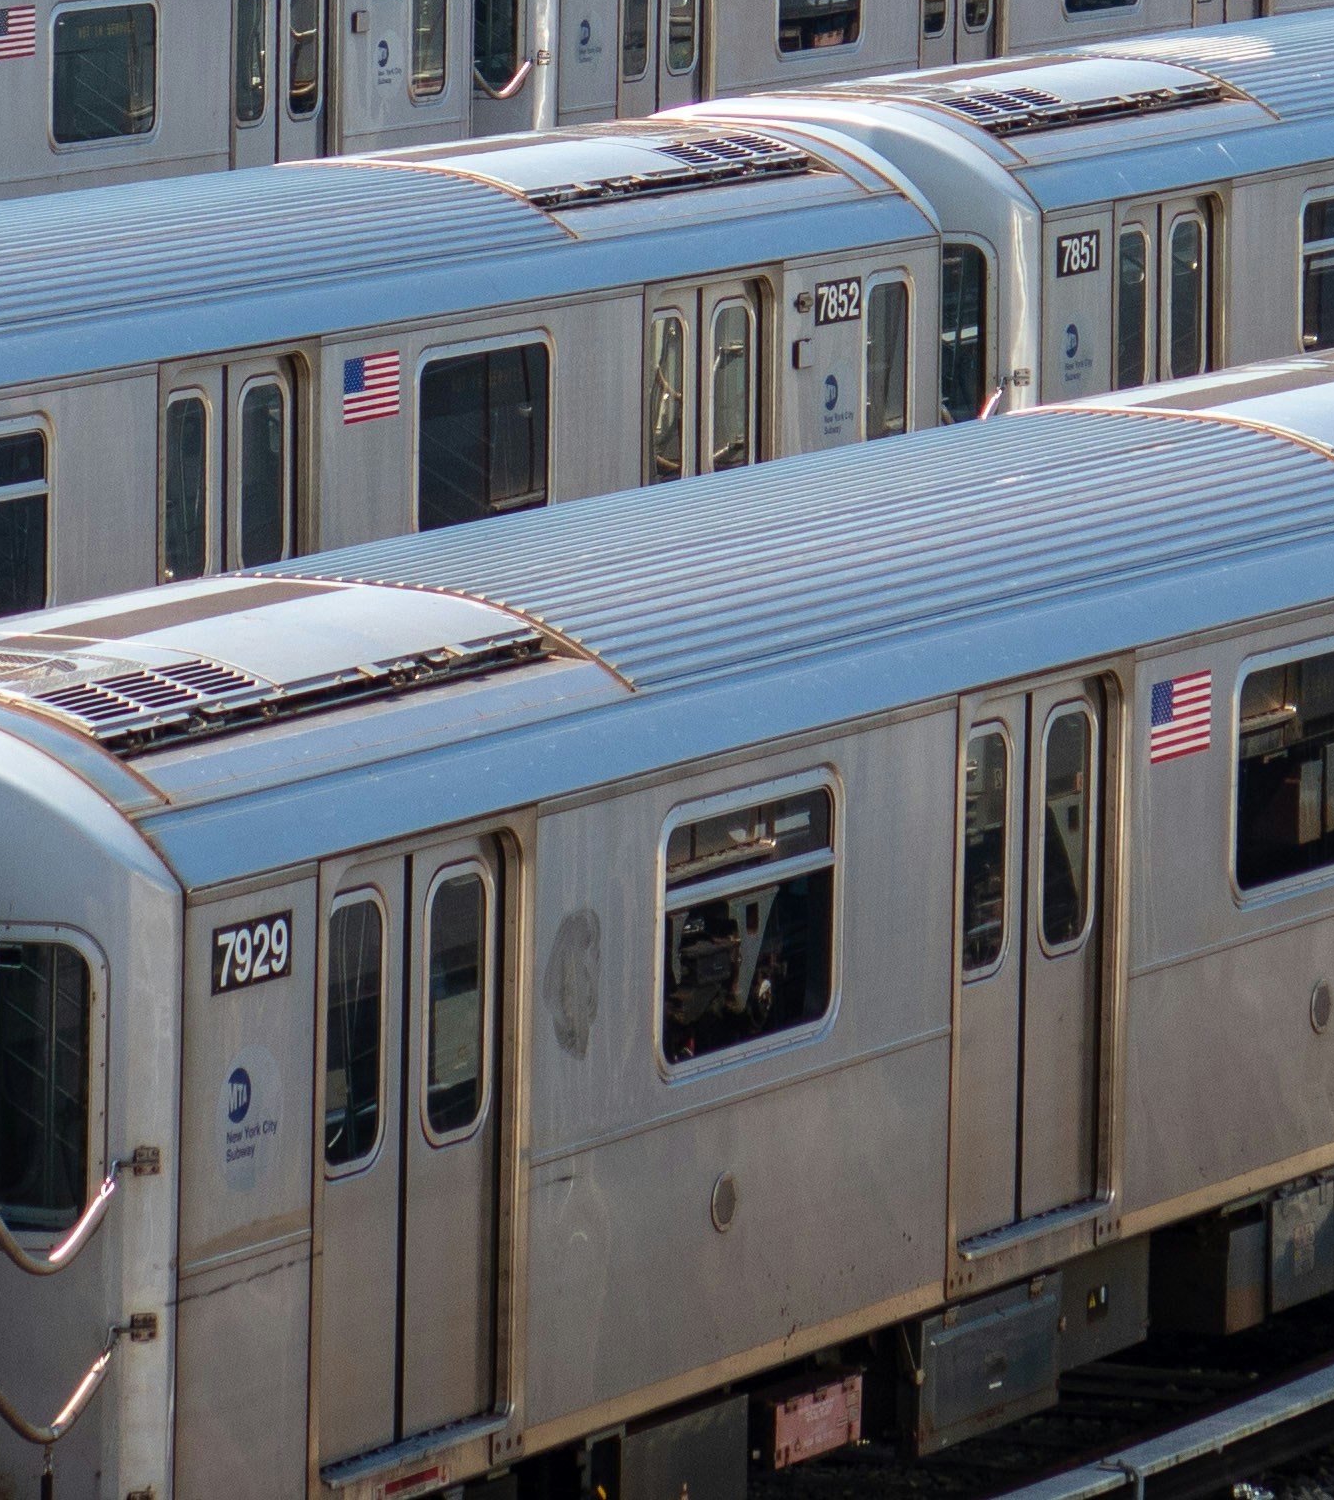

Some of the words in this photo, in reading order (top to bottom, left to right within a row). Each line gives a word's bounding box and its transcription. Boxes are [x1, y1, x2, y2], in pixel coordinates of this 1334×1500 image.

[1062, 234, 1097, 273] 7851
[818, 281, 859, 322] 7852
[217, 918, 289, 988] 7929
[226, 1130, 242, 1145] New
[245, 1126, 261, 1140] York
[263, 1120, 279, 1137] City
[226, 1144, 255, 1164] Subway
